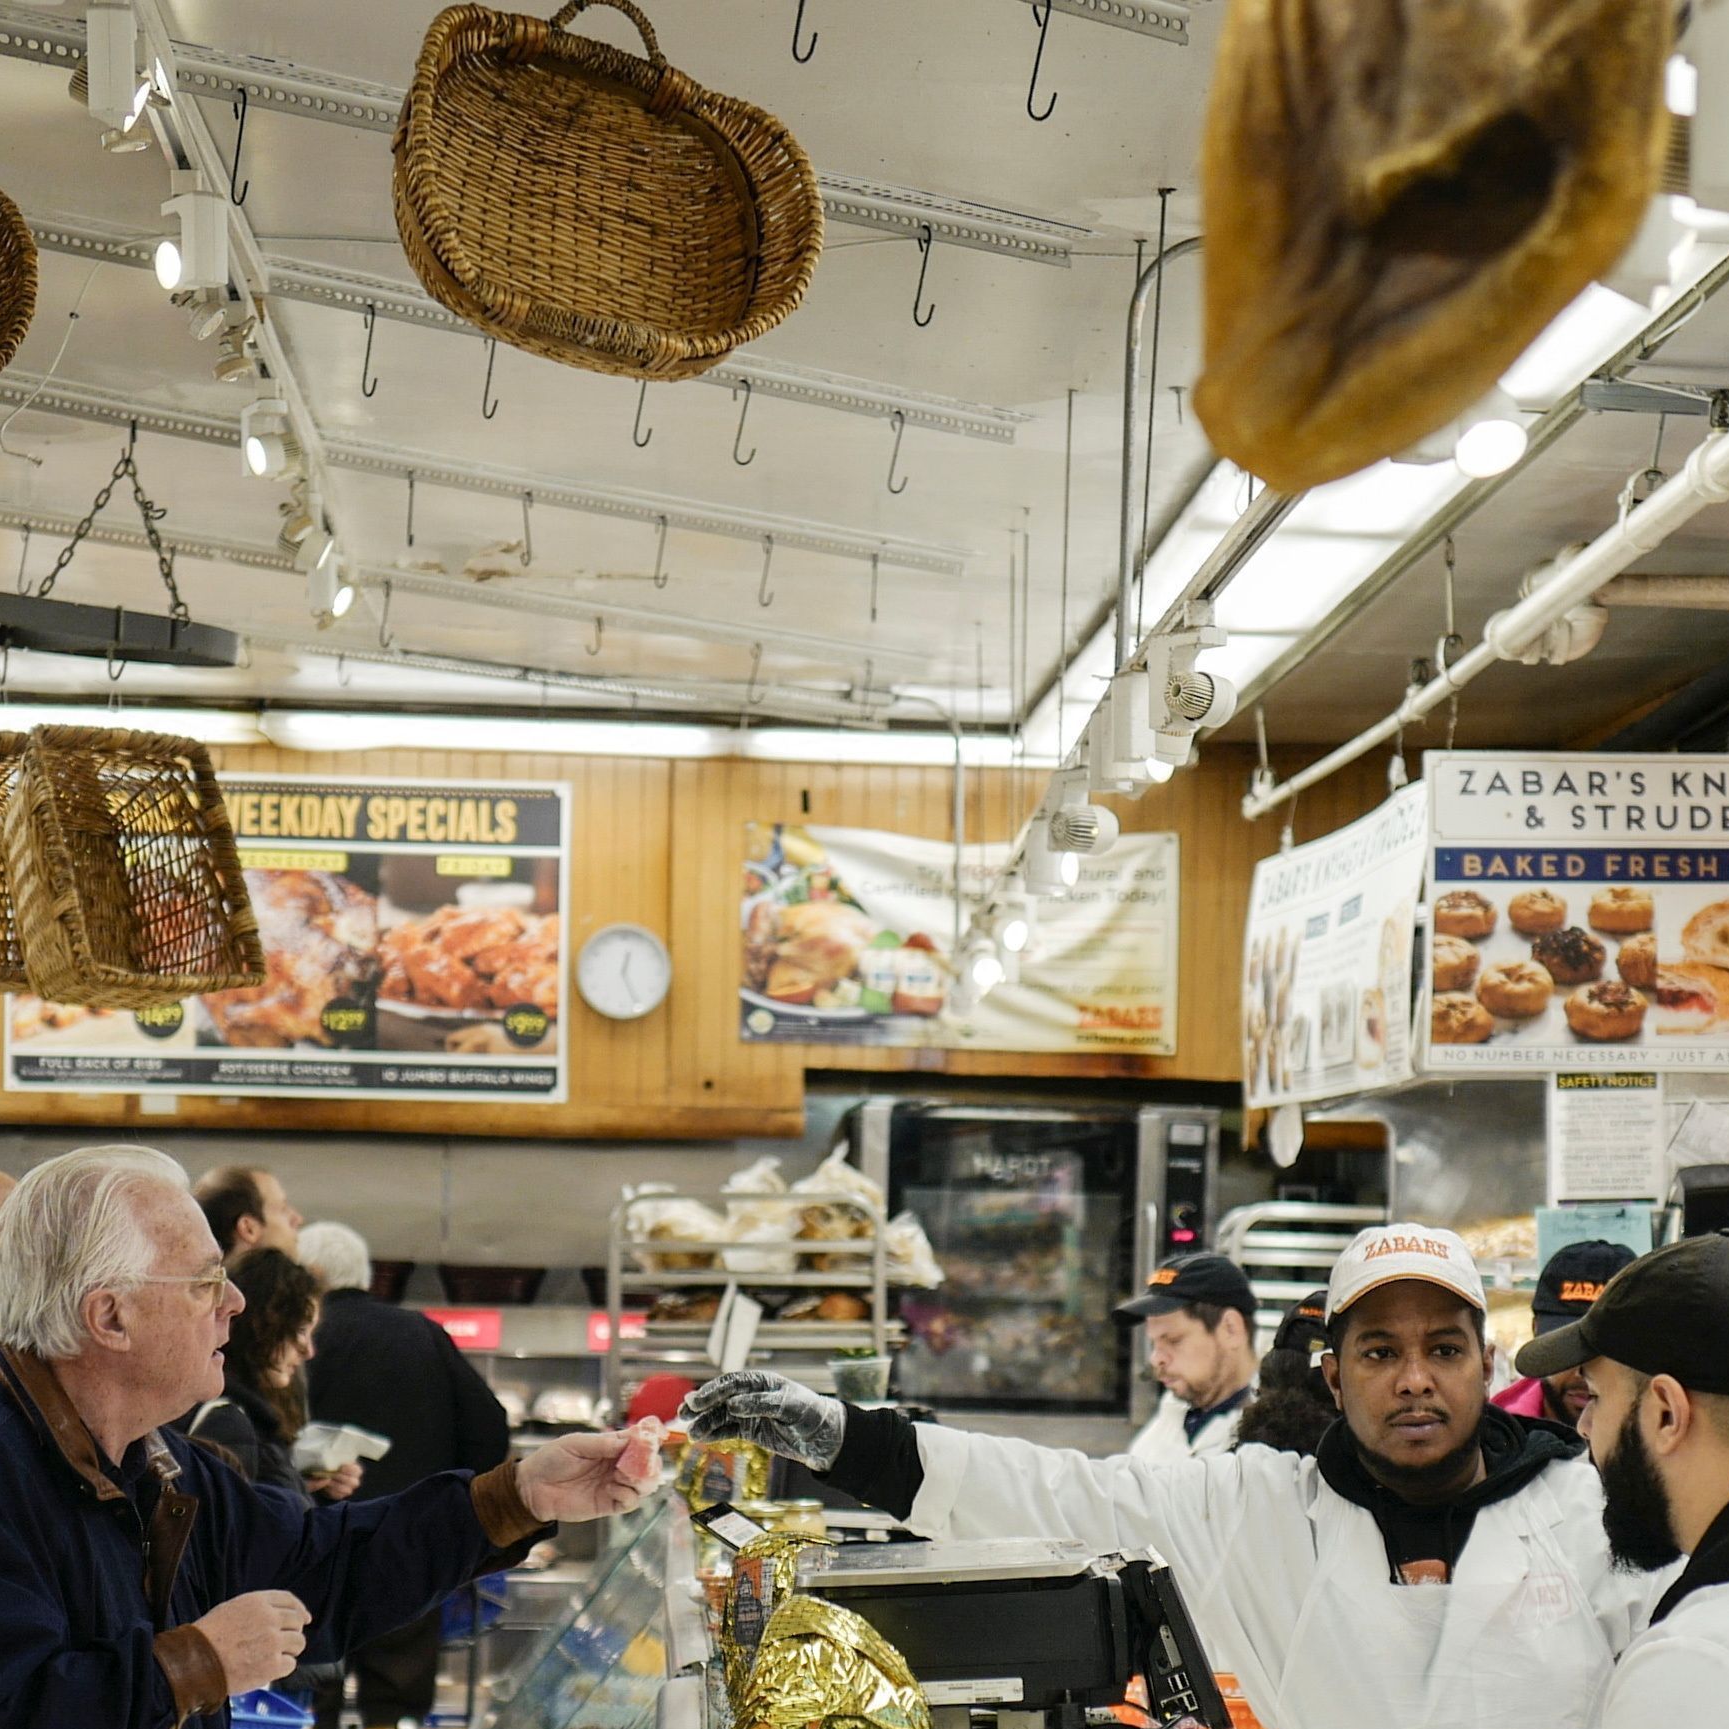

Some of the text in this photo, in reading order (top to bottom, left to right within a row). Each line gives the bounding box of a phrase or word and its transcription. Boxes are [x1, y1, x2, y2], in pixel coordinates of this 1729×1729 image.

[1460, 770, 1646, 796] ZABAR'S
[366, 798, 518, 843] SPECIALS
[1525, 805, 1545, 828] &
[1462, 854, 1586, 878] BAKED
[1605, 855, 1718, 878] FRESH
[1444, 1049, 1649, 1063] NO NUMBER NECESSARY
[1667, 1050, 1706, 1063] JUST
[1558, 1075, 1656, 1088] SAFETY NOTICE
